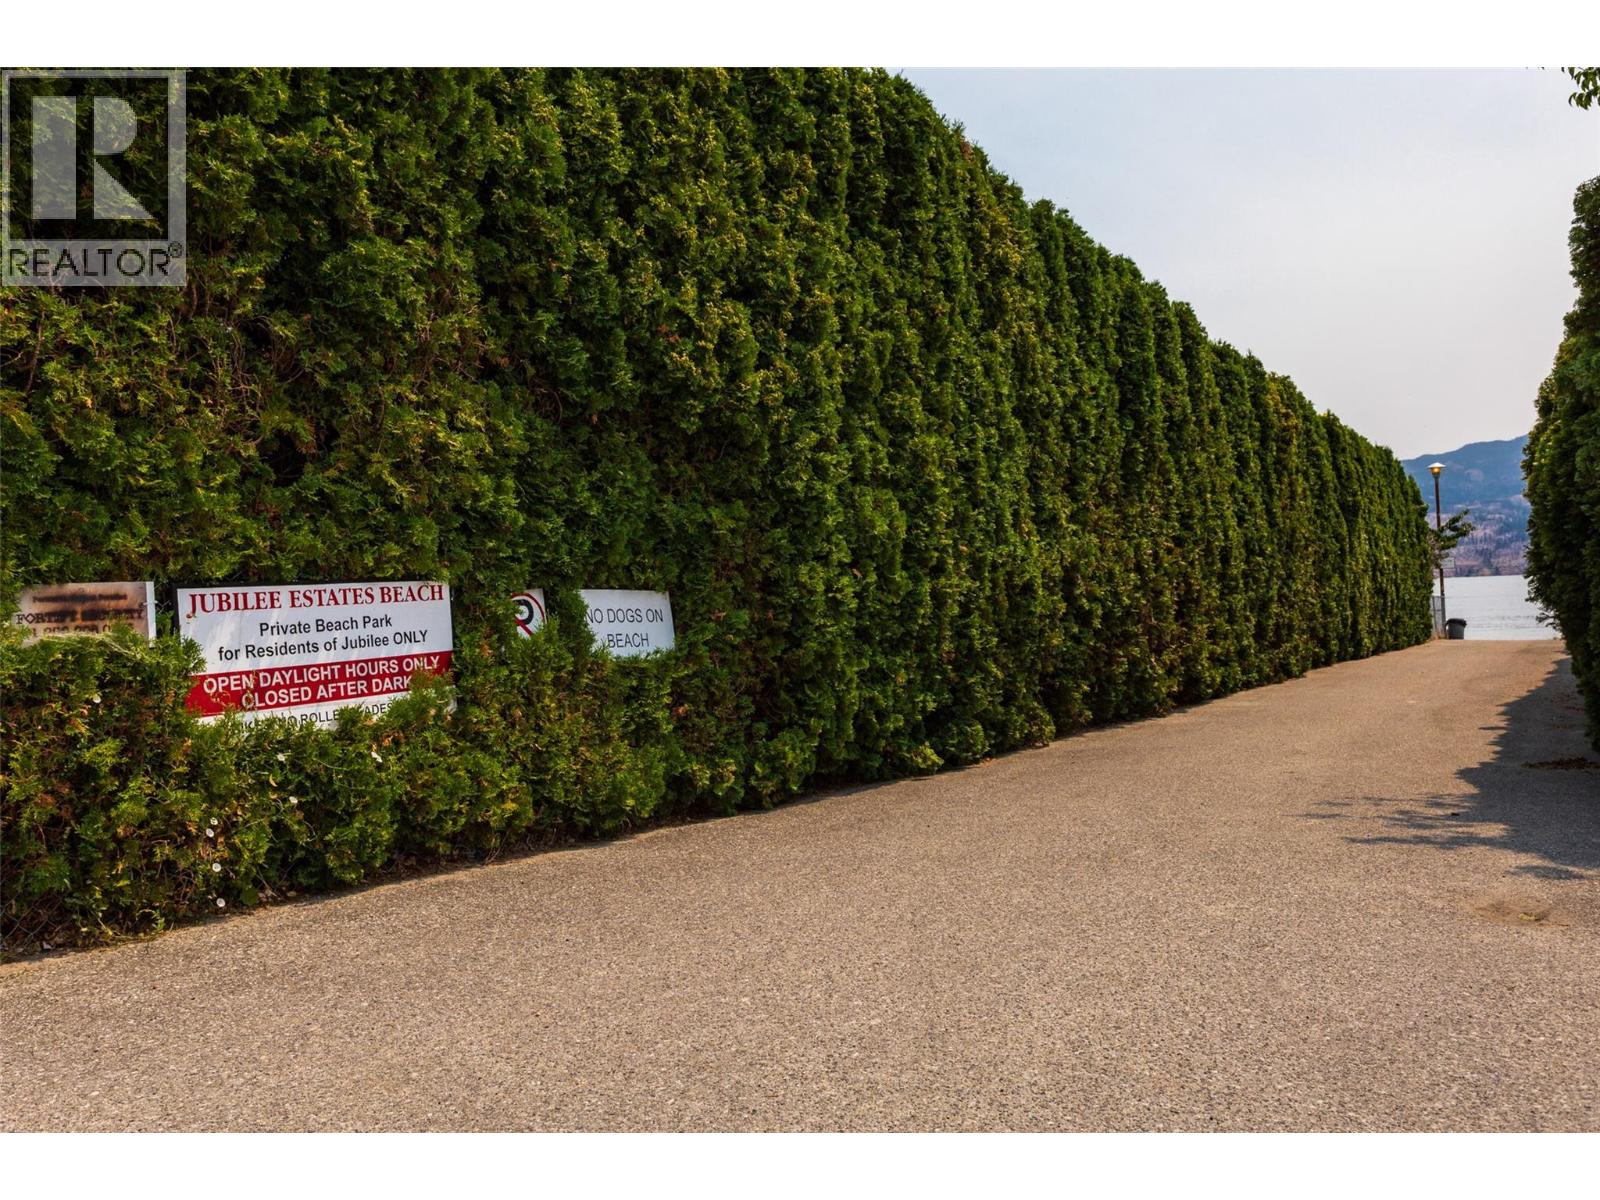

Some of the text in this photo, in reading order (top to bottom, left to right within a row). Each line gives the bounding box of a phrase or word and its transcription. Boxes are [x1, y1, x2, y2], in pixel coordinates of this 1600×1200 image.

[186, 584, 444, 618] JUBILEE ESTATES BEACH
[585, 608, 664, 624] NO DOGS ON
[259, 614, 392, 637] Private Beach Park
[607, 633, 650, 648] BEACH
[218, 630, 428, 661] for Residents of Jubilee ONLY
[203, 655, 440, 694] OPEN DAYLIGHT HOURS ONLY
[242, 676, 412, 708] CLOSED AFTER DARK
